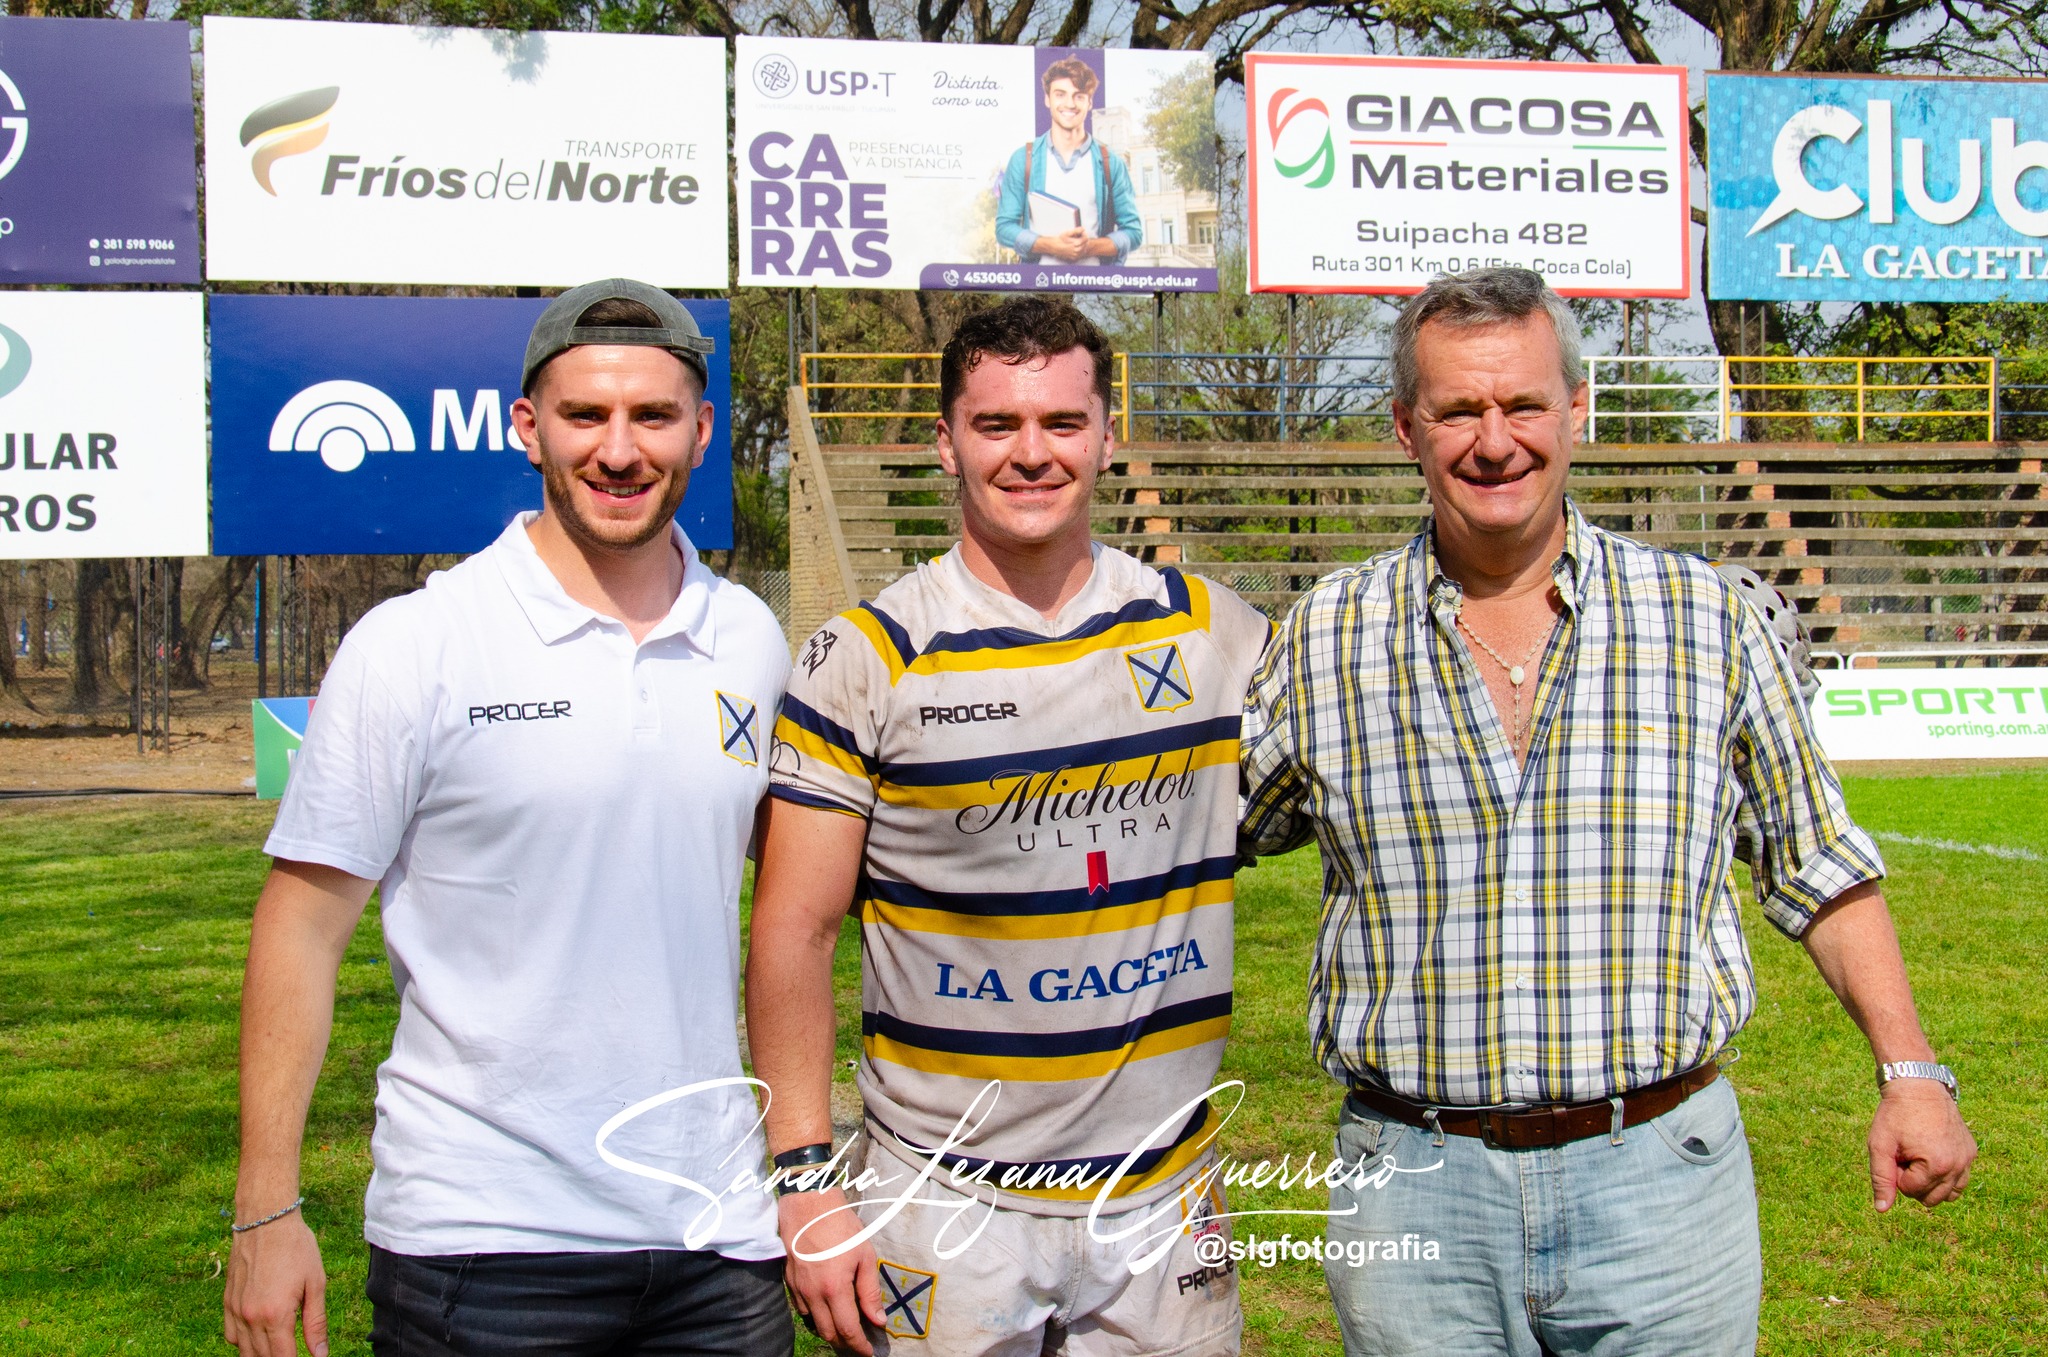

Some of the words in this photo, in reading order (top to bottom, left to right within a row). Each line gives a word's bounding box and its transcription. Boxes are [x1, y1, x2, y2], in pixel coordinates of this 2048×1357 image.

[932, 96, 972, 107] como
[975, 98, 999, 108] vos
[1346, 94, 1665, 138] GIACOSA
[564, 139, 699, 161] TRANSPORTE
[748, 131, 849, 180] CA
[849, 141, 963, 156] PRESENCIALES
[852, 156, 862, 167] Y
[866, 157, 877, 168] A
[881, 157, 963, 170] DISTANCIA
[1351, 153, 1670, 195] Materiales
[1745, 99, 2048, 238] Club
[750, 180, 888, 229] RRE
[103, 238, 123, 250] 381
[126, 238, 147, 250] 598
[148, 239, 175, 250] 9066
[1356, 219, 1509, 250] Suipacha
[1518, 223, 1588, 246] 482
[751, 228, 892, 278] RAS
[1312, 255, 1359, 272] Ruta
[1365, 256, 1404, 272] 301
[1412, 256, 1442, 273] Km
[1533, 258, 1580, 274] Coca
[1585, 259, 1632, 279] Cola)
[1776, 243, 1850, 278] LA
[1862, 244, 2048, 280] GACET
[963, 272, 1021, 285] 4530630
[1052, 272, 1198, 289] informes@uspt.edu.ar
[469, 700, 573, 727] PROCER
[920, 702, 1021, 727] PROCER
[1017, 812, 1171, 852] ULTRA
[934, 962, 1014, 1003] LA
[1028, 938, 1209, 1003] GACETA
